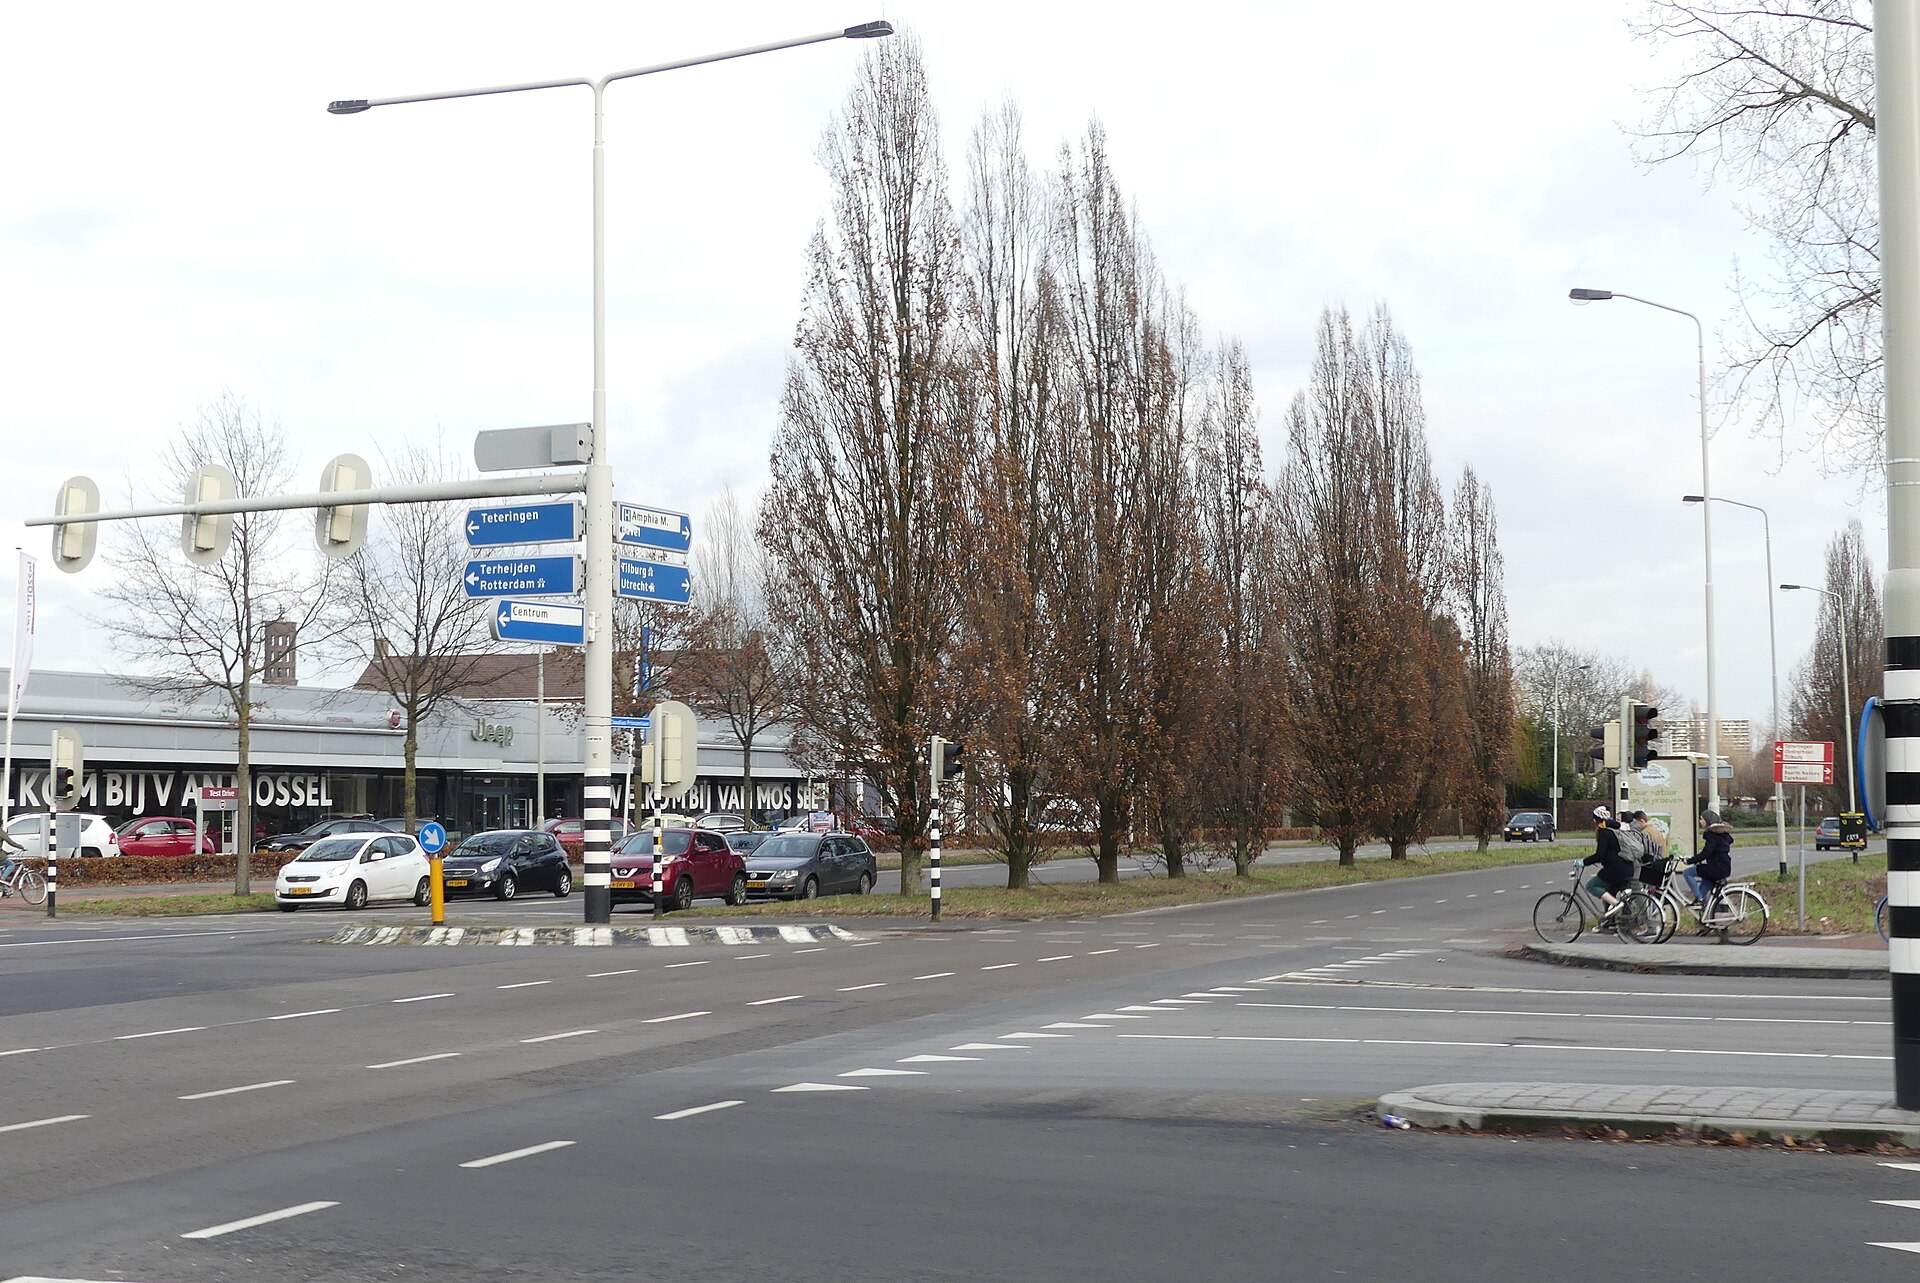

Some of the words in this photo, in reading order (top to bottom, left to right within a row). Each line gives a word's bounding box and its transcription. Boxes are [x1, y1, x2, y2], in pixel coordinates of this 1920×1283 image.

[481, 511, 539, 523] Teteringen
[632, 511, 659, 525] Amphia
[660, 516, 669, 527] M.
[480, 563, 536, 576] Terheijden
[621, 562, 647, 578] Tilburg
[480, 578, 535, 591] Rotterdam
[621, 578, 648, 592] Utrecht
[512, 605, 548, 619] Centrum
[471, 716, 514, 747] Jeep
[106, 773, 145, 815] BIJ
[209, 789, 221, 797] Test
[221, 789, 235, 797] Drive
[689, 784, 711, 814] BIJ
